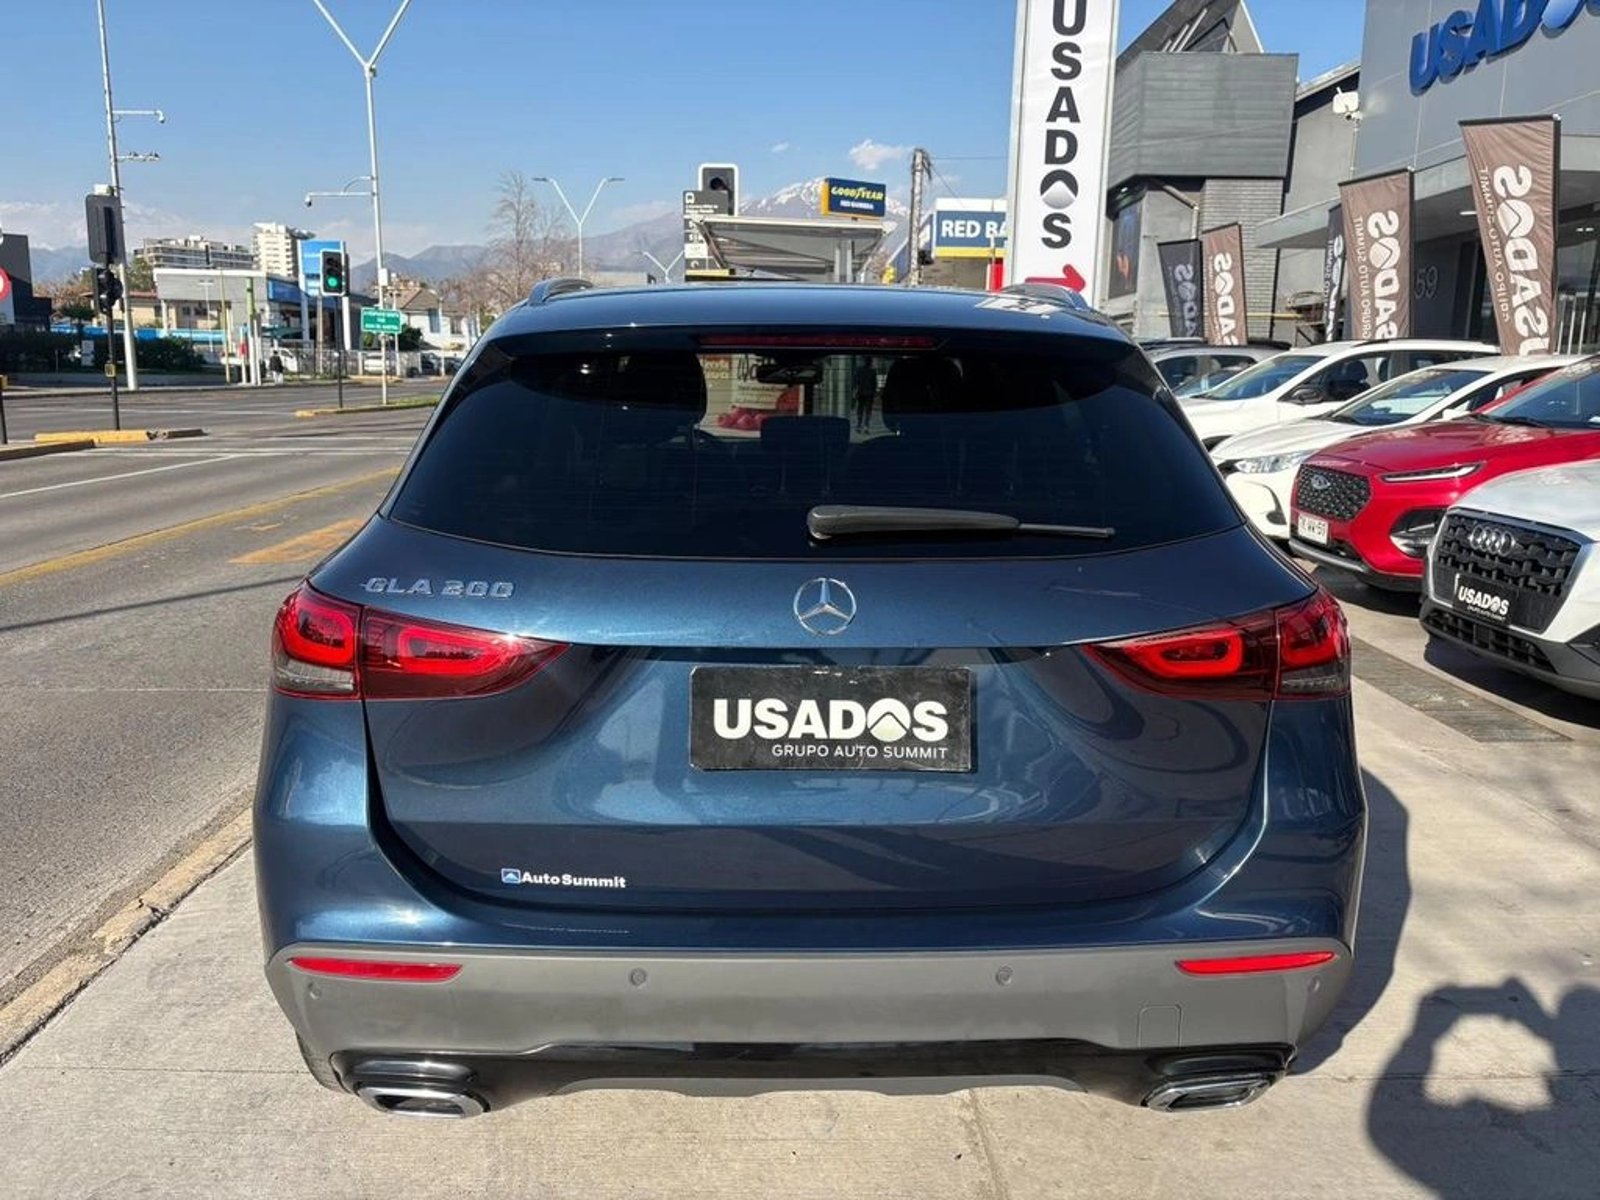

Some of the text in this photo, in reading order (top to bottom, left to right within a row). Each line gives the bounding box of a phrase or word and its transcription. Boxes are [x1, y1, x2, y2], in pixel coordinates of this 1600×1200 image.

[1040, 0, 1087, 249] USADOS
[831, 186, 884, 200] GOODYEAR
[941, 219, 981, 238] RED
[361, 577, 514, 598] GLA 200
[1458, 585, 1510, 615] USADOS
[713, 697, 949, 742] USADOS
[771, 744, 949, 759] GRUPO AUTO SUMMIT
[521, 871, 627, 889] Auto Summit
